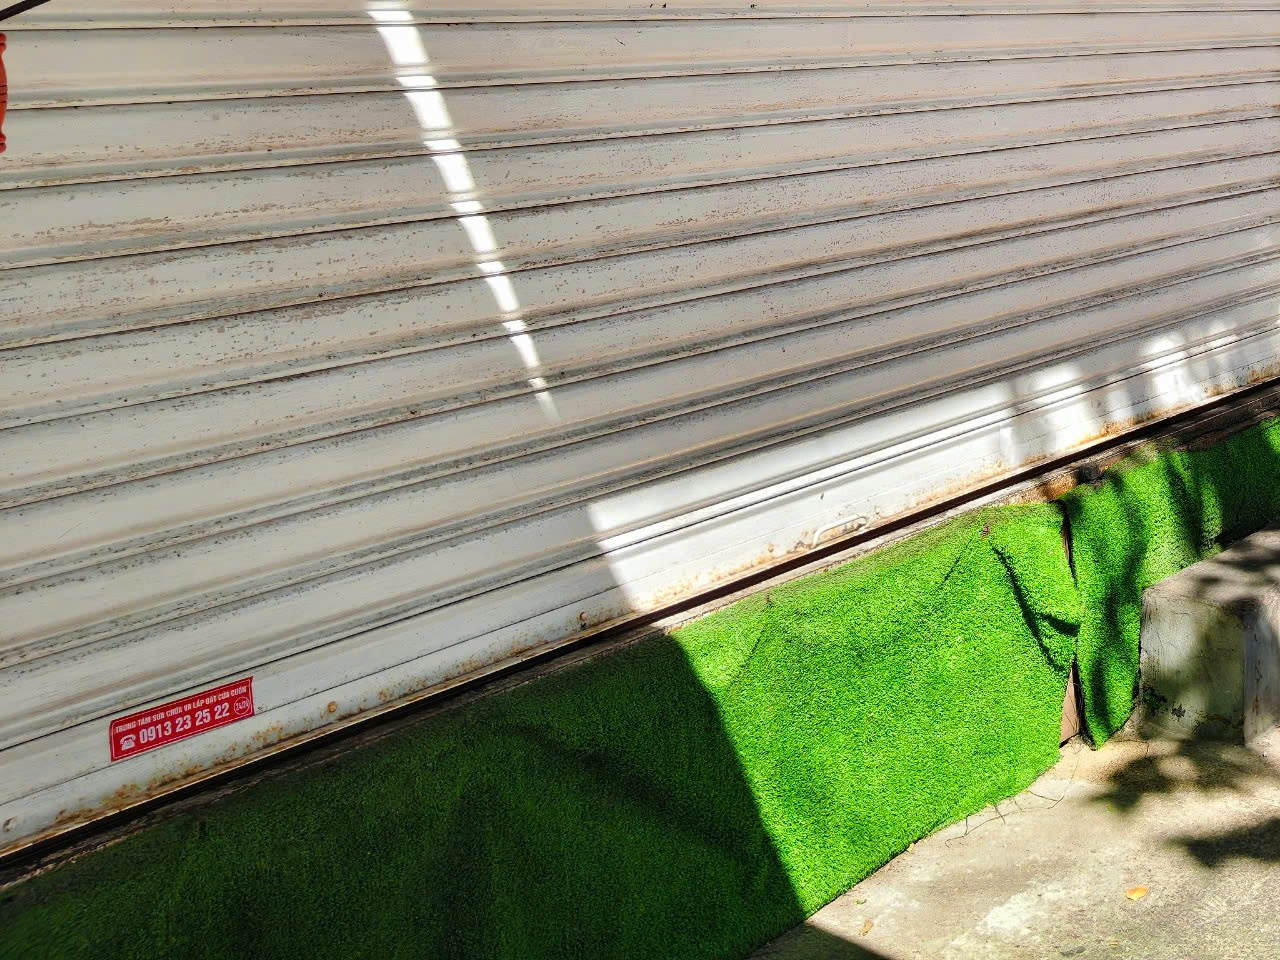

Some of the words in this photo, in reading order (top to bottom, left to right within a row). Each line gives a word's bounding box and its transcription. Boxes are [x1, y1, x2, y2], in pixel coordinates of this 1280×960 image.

[139, 722, 172, 744] 0913
[175, 715, 192, 733] 23
[195, 708, 211, 726] 25
[214, 702, 230, 720] 22
